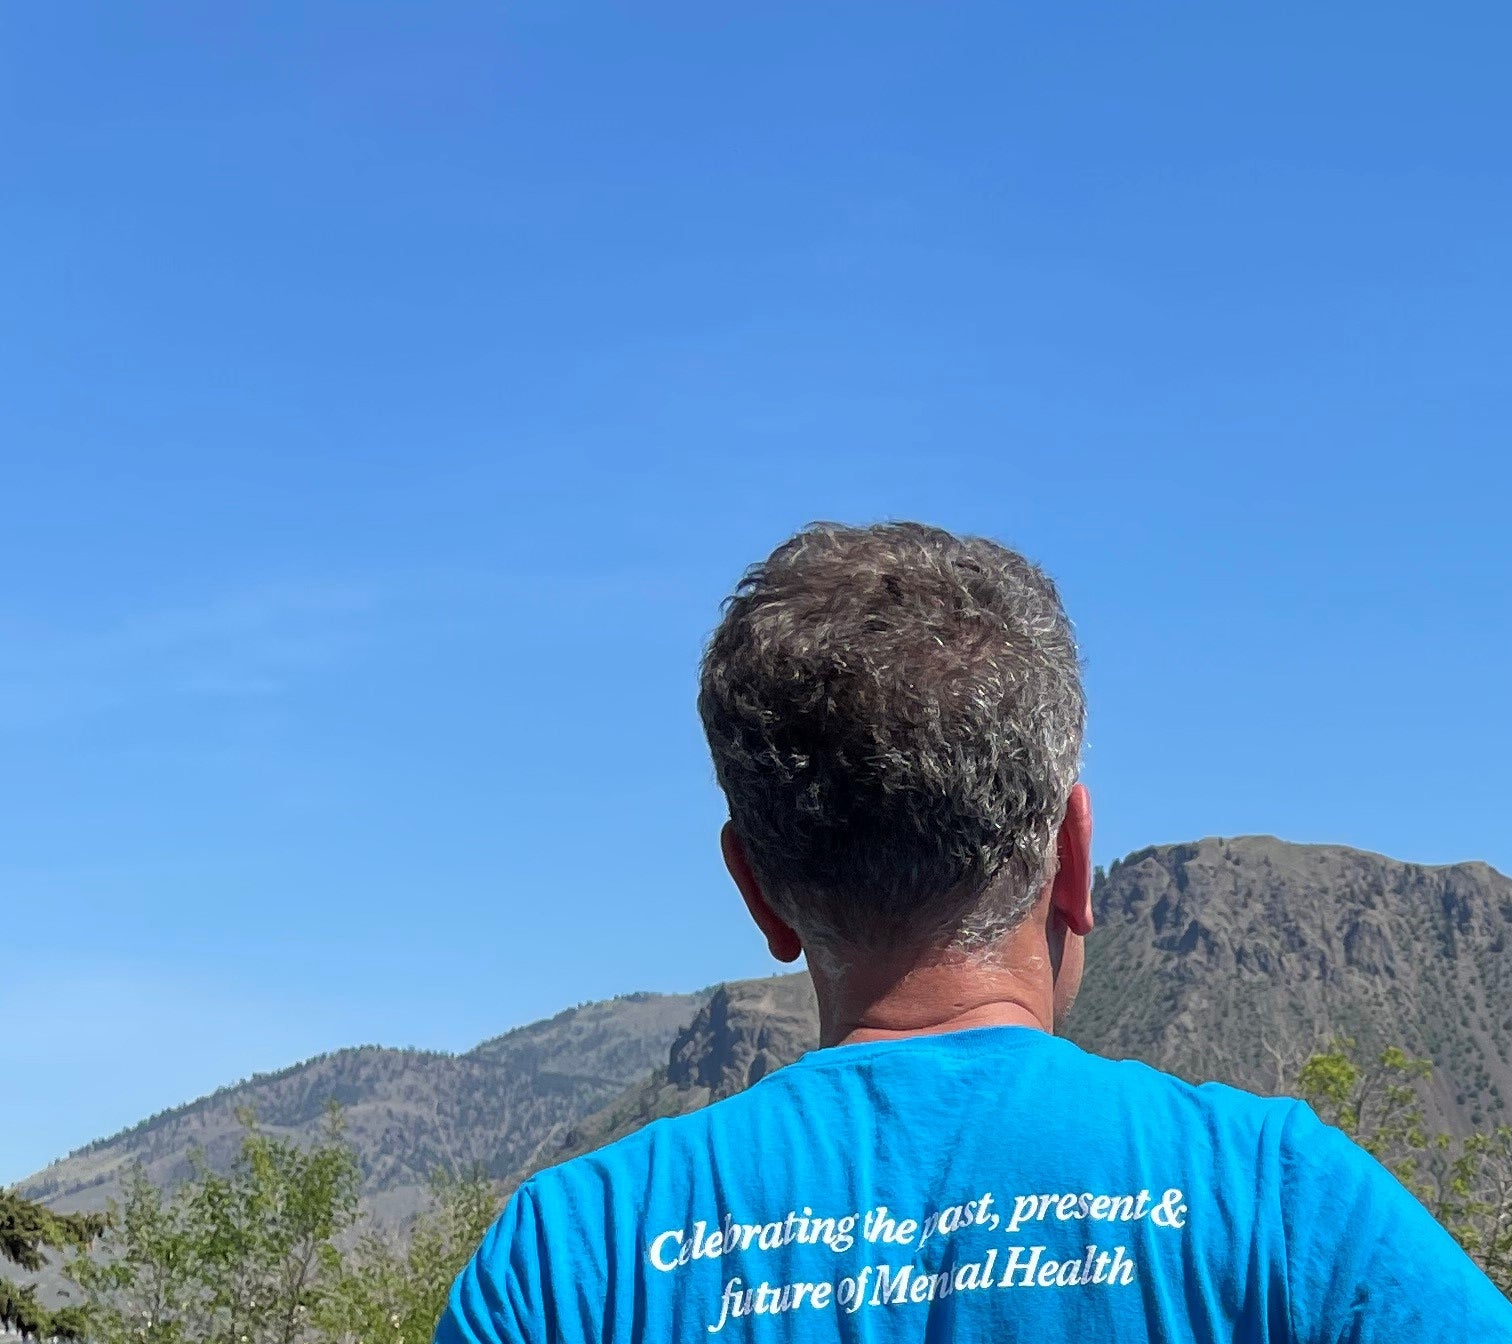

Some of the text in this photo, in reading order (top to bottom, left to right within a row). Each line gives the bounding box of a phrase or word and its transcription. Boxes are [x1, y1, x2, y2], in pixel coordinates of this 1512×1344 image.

[649, 1188, 1187, 1272] Celebrating the past, present &
[707, 1276, 832, 1333] future
[837, 1265, 873, 1314] of
[997, 1244, 1134, 1288] Health
